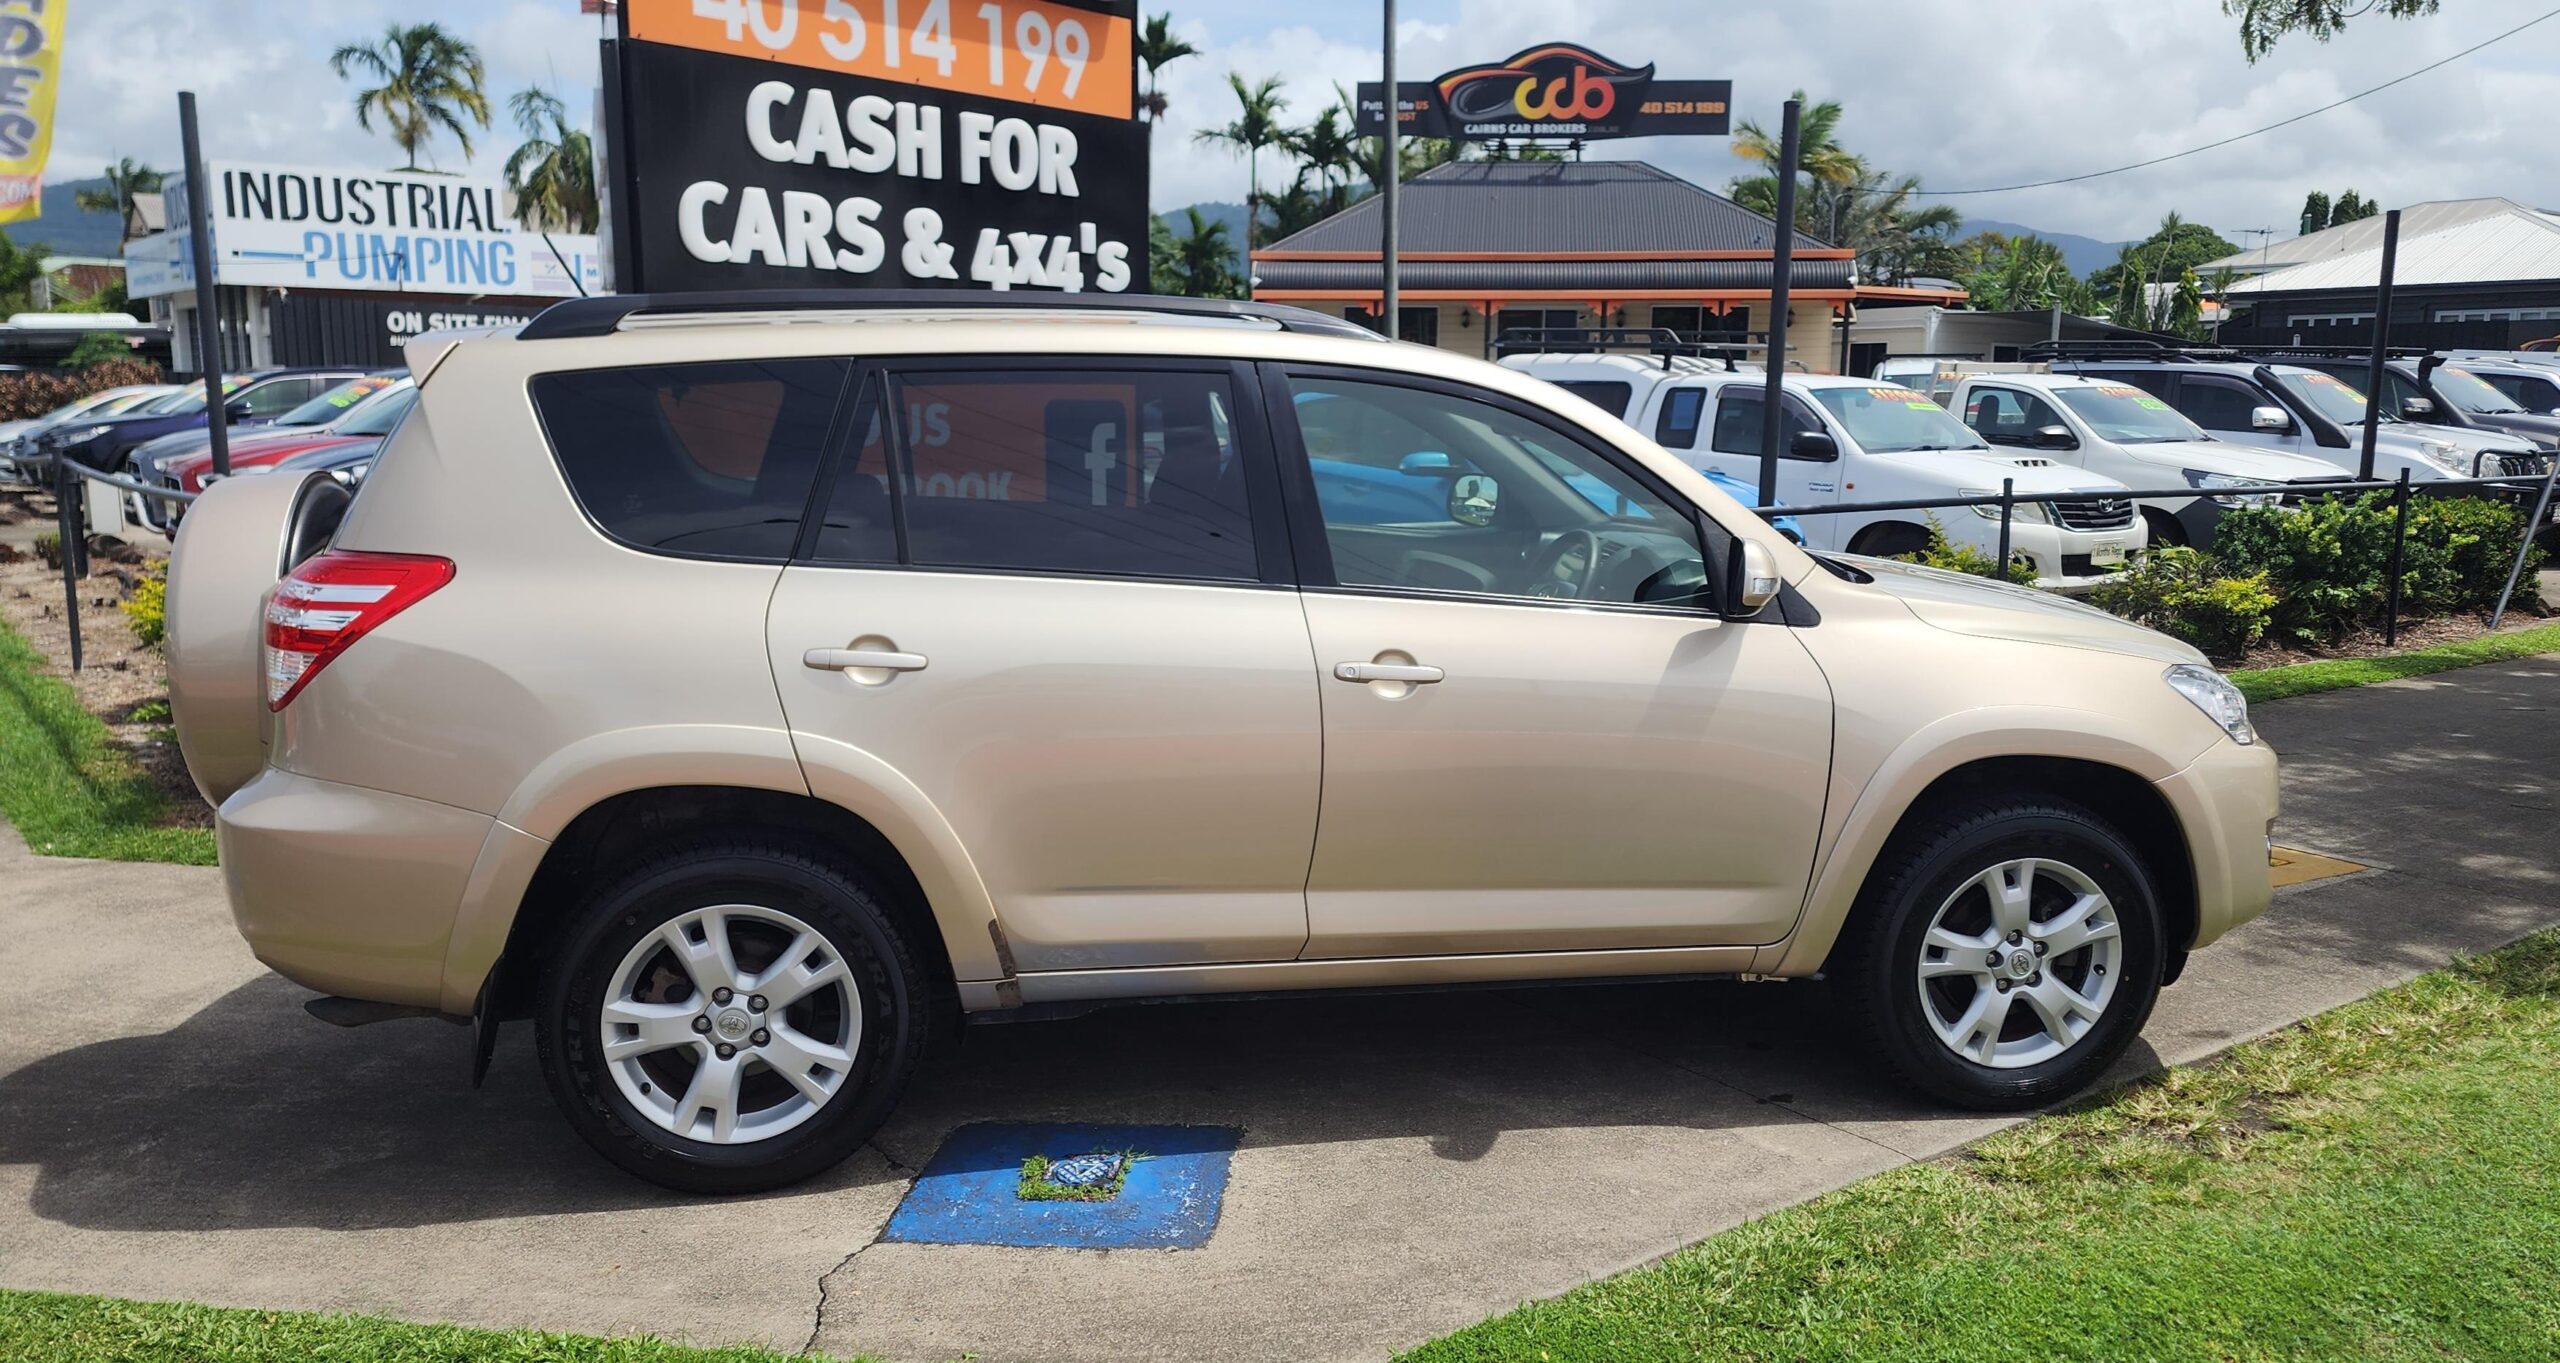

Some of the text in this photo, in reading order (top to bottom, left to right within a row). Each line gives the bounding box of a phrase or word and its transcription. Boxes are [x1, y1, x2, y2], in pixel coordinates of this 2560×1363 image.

[692, 0, 1090, 100] 40 514 199
[746, 80, 1079, 197] CASH FOR
[1464, 123, 1506, 134] CAIRNS
[1508, 123, 1531, 134] CAR
[1533, 123, 1587, 134] BROKERS
[304, 230, 516, 286] PUMPING
[678, 180, 885, 273] CARS
[901, 207, 959, 280] &
[386, 311, 423, 333] ON
[428, 313, 479, 332] SITE
